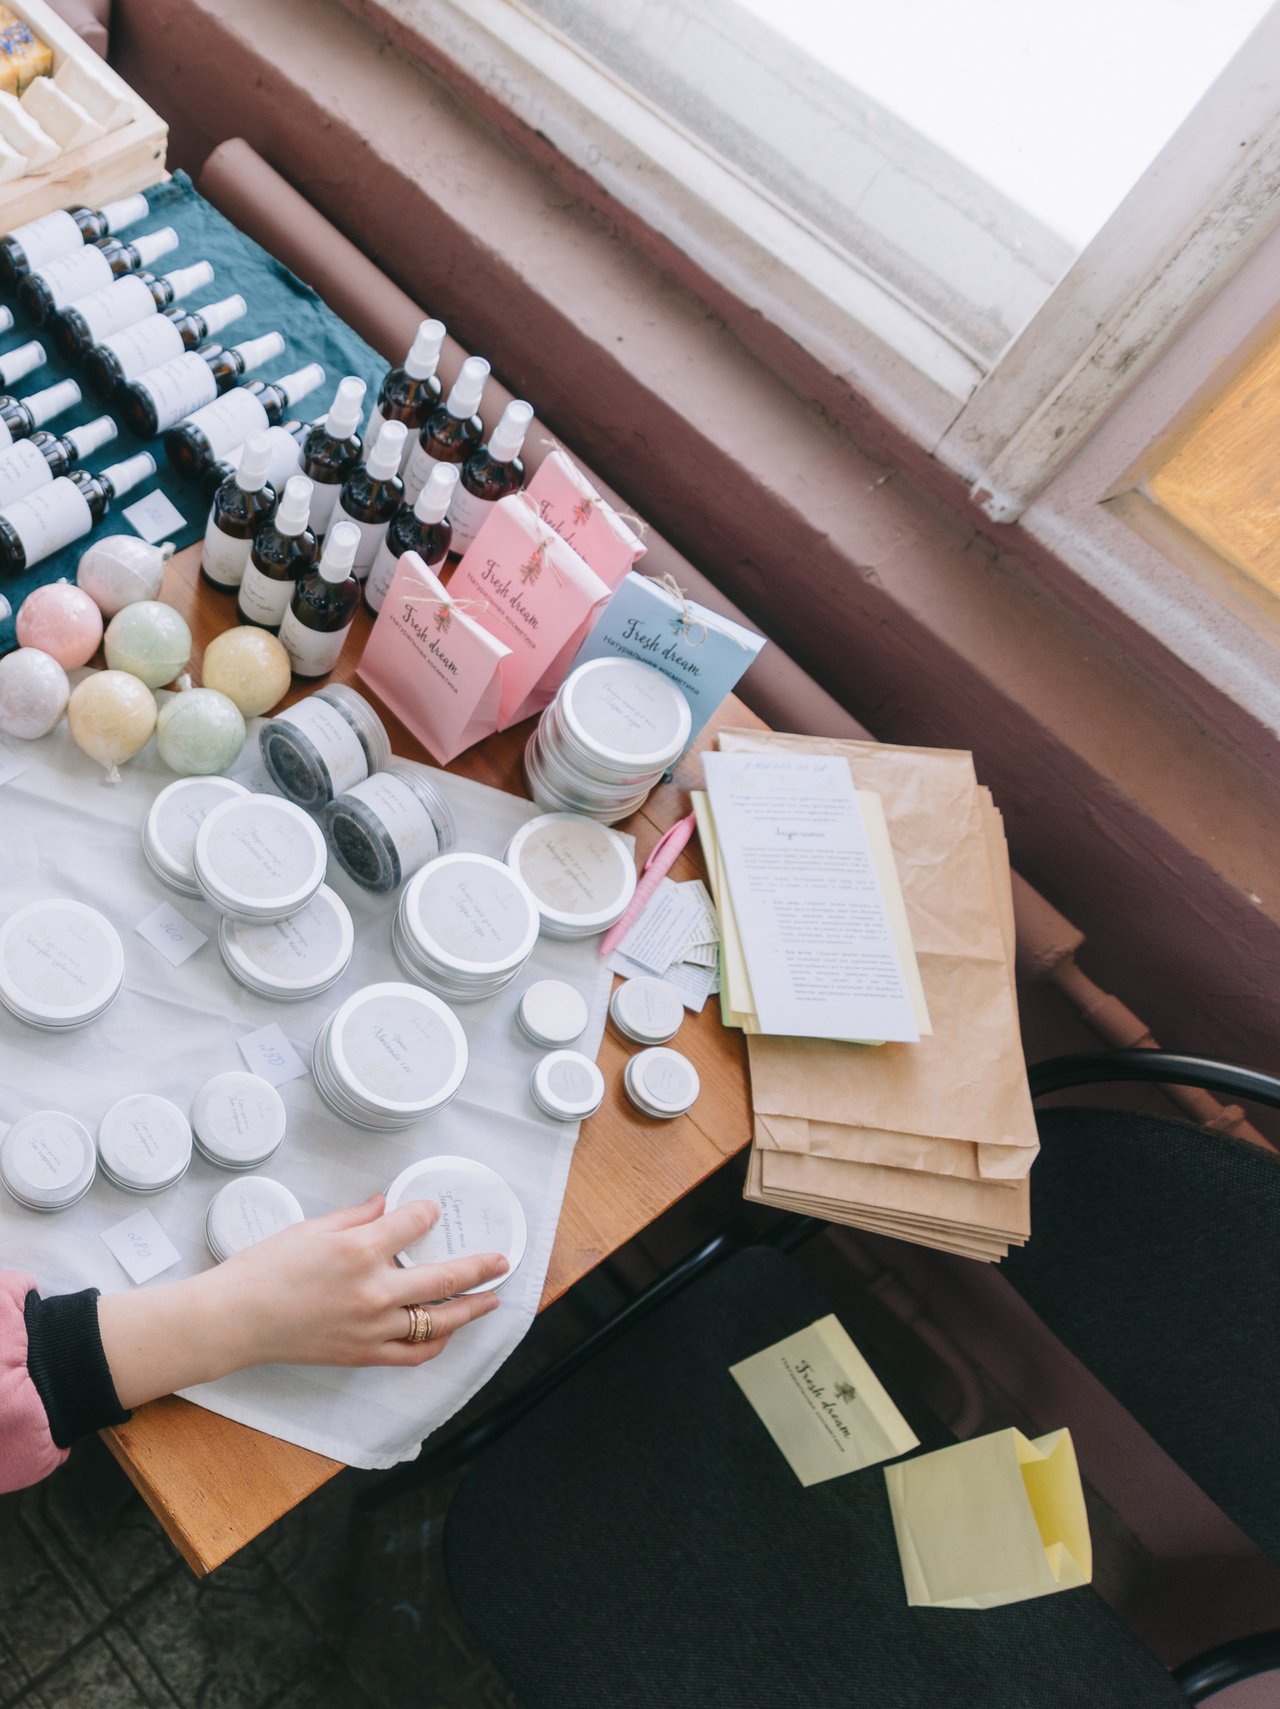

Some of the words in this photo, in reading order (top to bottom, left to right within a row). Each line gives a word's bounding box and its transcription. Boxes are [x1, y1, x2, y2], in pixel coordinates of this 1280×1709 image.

[481, 559, 512, 598] Fresh
[508, 592, 539, 629] dream
[402, 604, 428, 642] Fresh
[428, 639, 458, 675] dream
[603, 635, 657, 668] Натуральная
[622, 618, 661, 652] Fresh
[661, 642, 701, 677] dream
[426, 659, 458, 694] косметика
[159, 920, 184, 943] 300
[126, 1232, 151, 1258] 280
[794, 1359, 825, 1398] Fresh
[821, 1401, 851, 1439] dream
